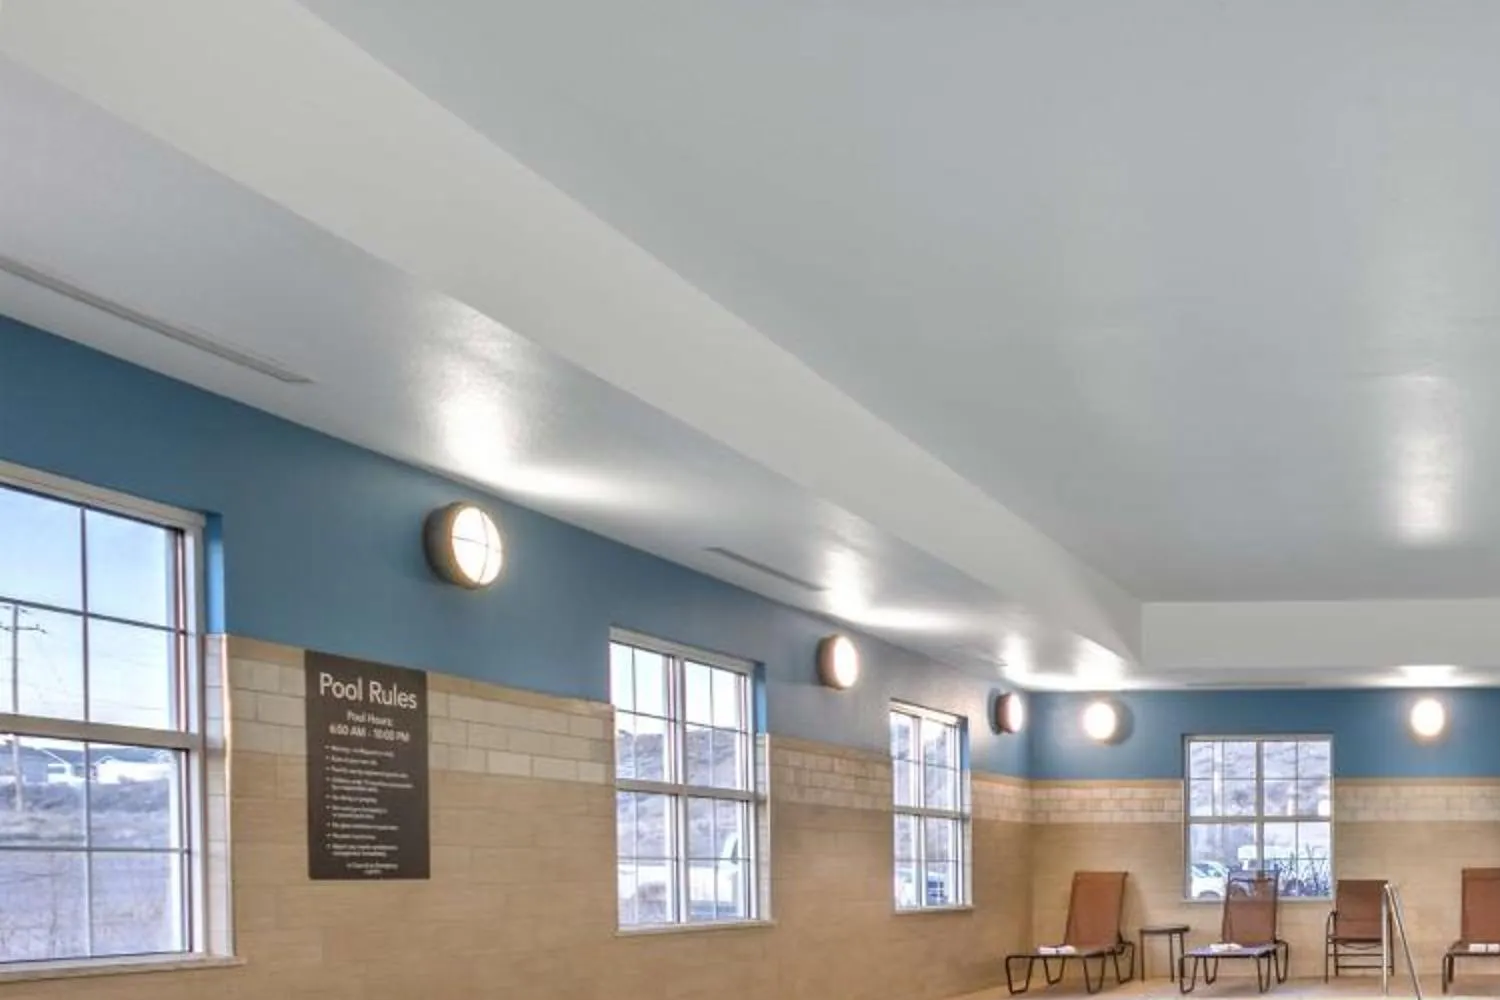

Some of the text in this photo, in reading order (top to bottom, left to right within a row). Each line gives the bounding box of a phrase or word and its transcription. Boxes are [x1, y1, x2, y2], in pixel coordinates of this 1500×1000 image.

[319, 671, 417, 708] Pool Rules
[347, 709, 366, 723] Pool
[350, 725, 366, 737] AM
[395, 730, 410, 742] PM
